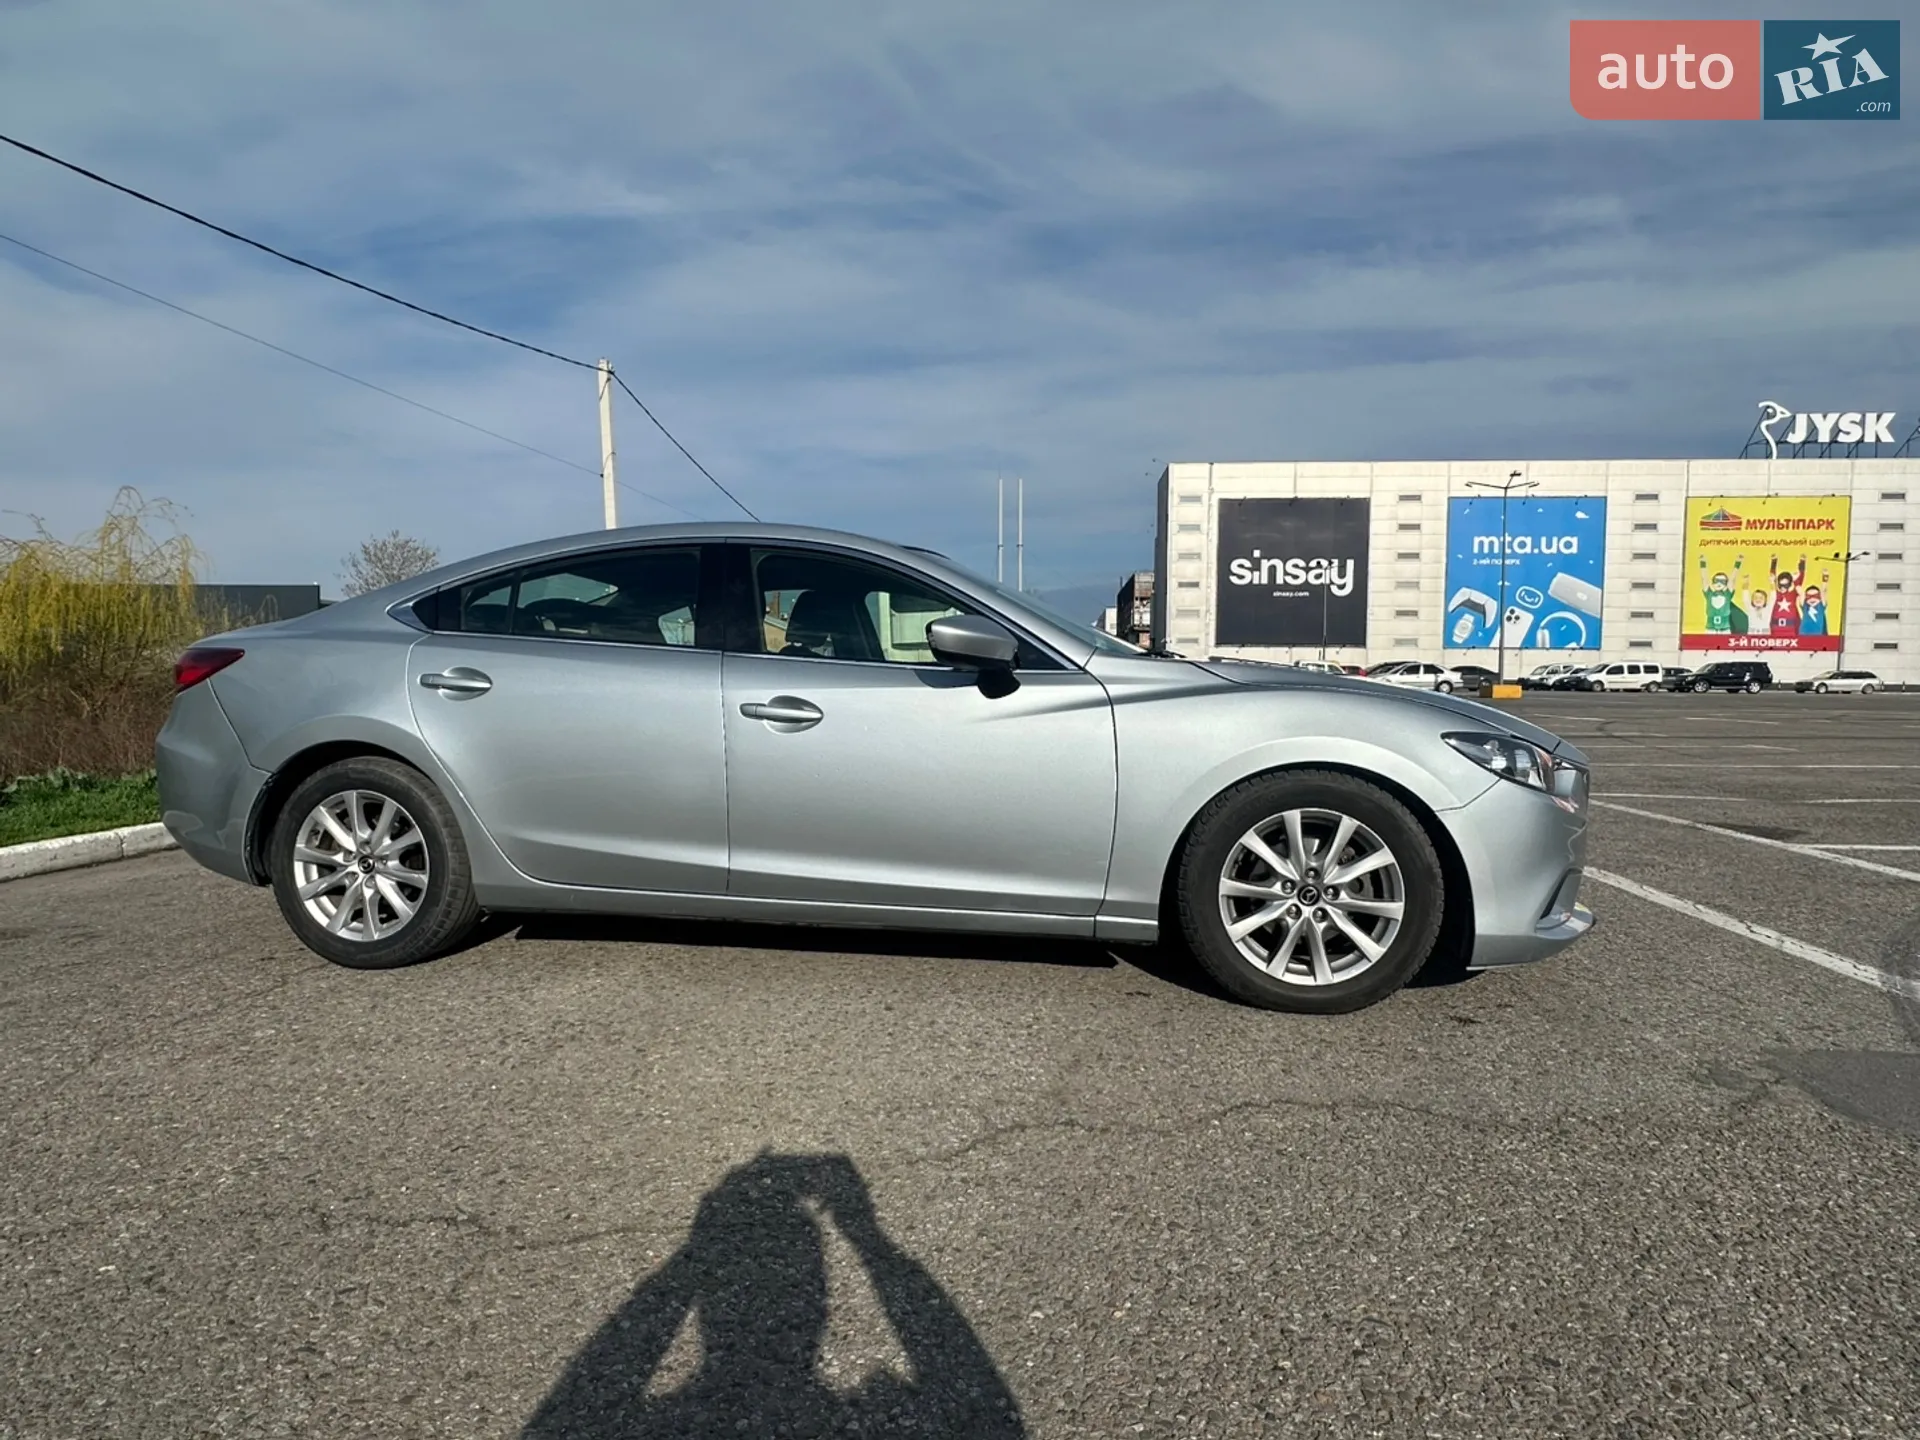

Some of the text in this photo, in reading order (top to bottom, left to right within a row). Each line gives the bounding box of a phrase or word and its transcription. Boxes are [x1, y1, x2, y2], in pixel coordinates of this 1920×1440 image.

[1786, 412, 1896, 444] JYSK
[1745, 518, 1835, 531] МУЛЬТІПАРК
[1473, 532, 1579, 554] mta.ua
[1699, 537, 1835, 547] ДИТЯЧИЙ РОЗВАЖАЛЬНИЙ ЦЕНТР
[1491, 558, 1521, 566] ПОЕРХ
[1229, 549, 1355, 597] sinsay
[1272, 590, 1310, 598] sinsay.com
[1728, 636, 1799, 648] 3-Й ПОВЕРХ
